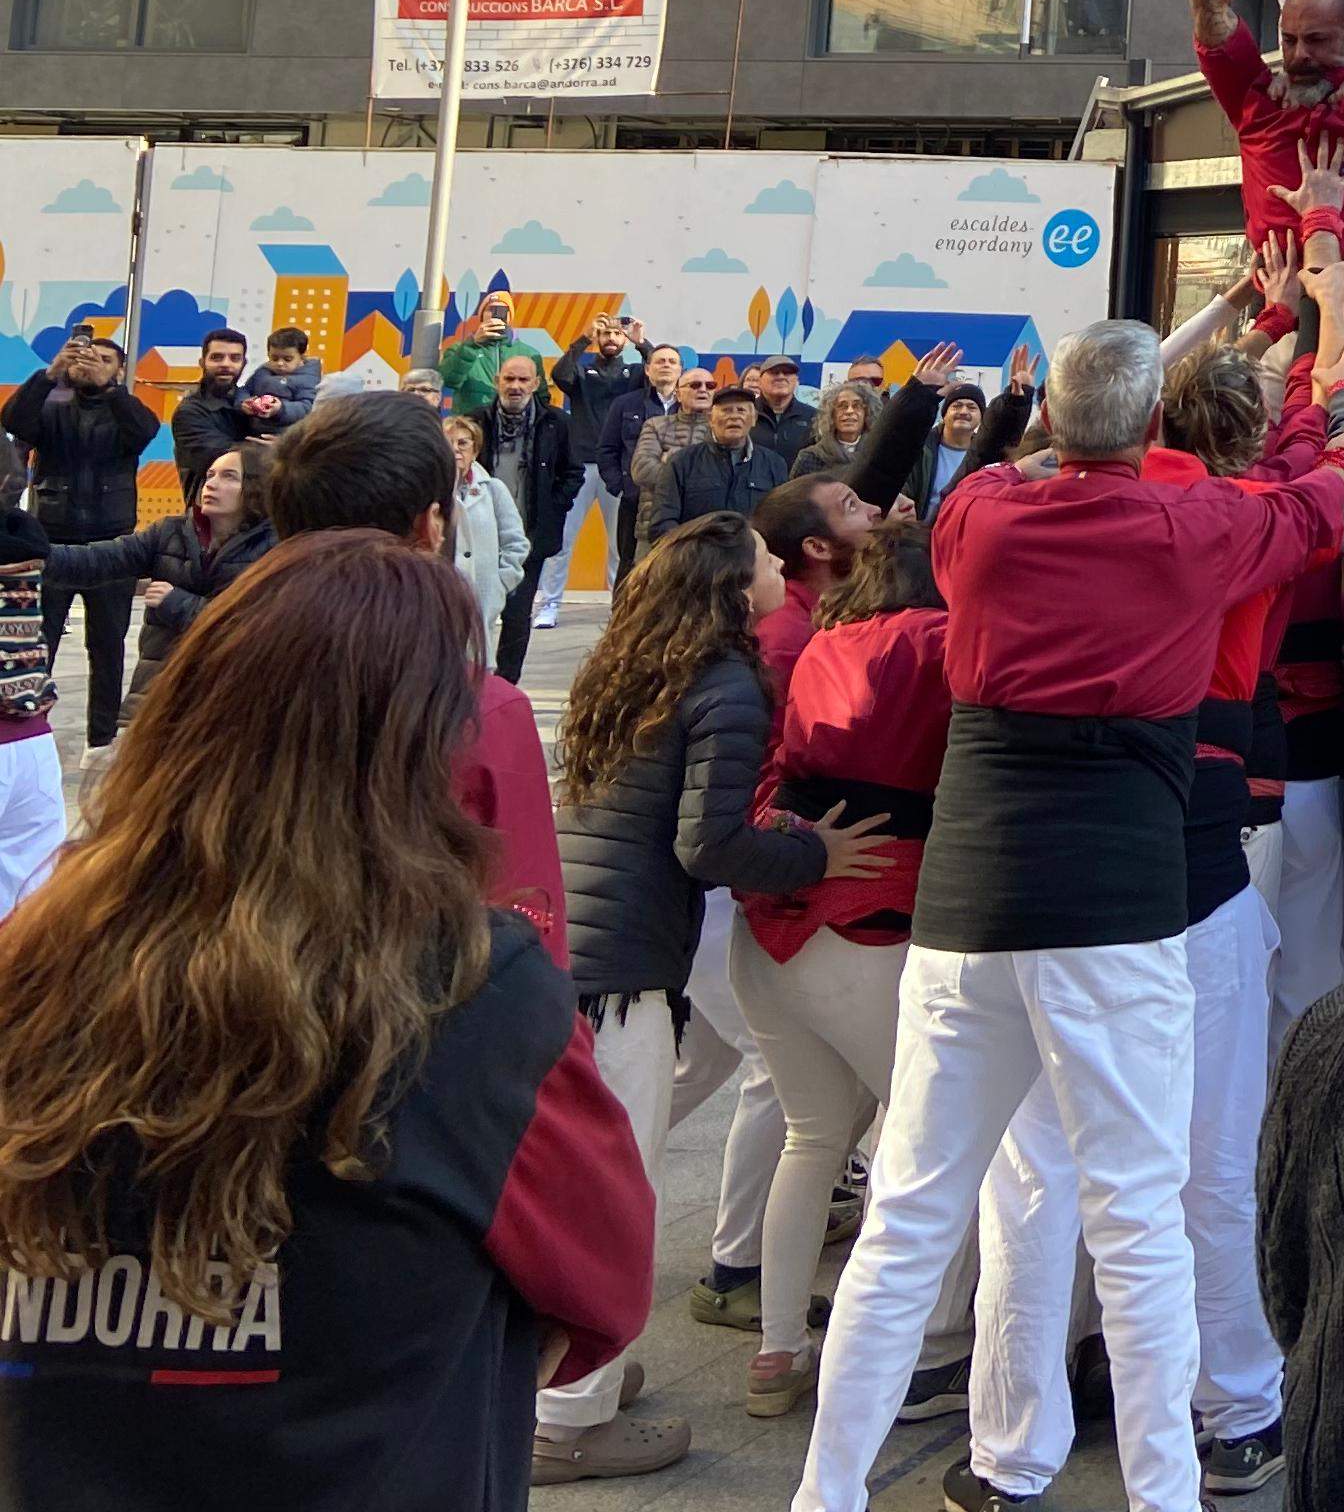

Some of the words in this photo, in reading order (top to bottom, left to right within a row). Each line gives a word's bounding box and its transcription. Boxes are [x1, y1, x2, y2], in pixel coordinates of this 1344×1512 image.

[420, 1, 528, 13] CONUCCIONS
[388, 59, 412, 72] Tel.
[464, 60, 490, 73] 833
[495, 59, 519, 72] 526
[549, 57, 591, 73] (+376)
[596, 57, 621, 69] 334
[626, 55, 652, 68] 729
[935, 235, 1033, 257] engordany
[0, 1254, 281, 1351] NDORRA
